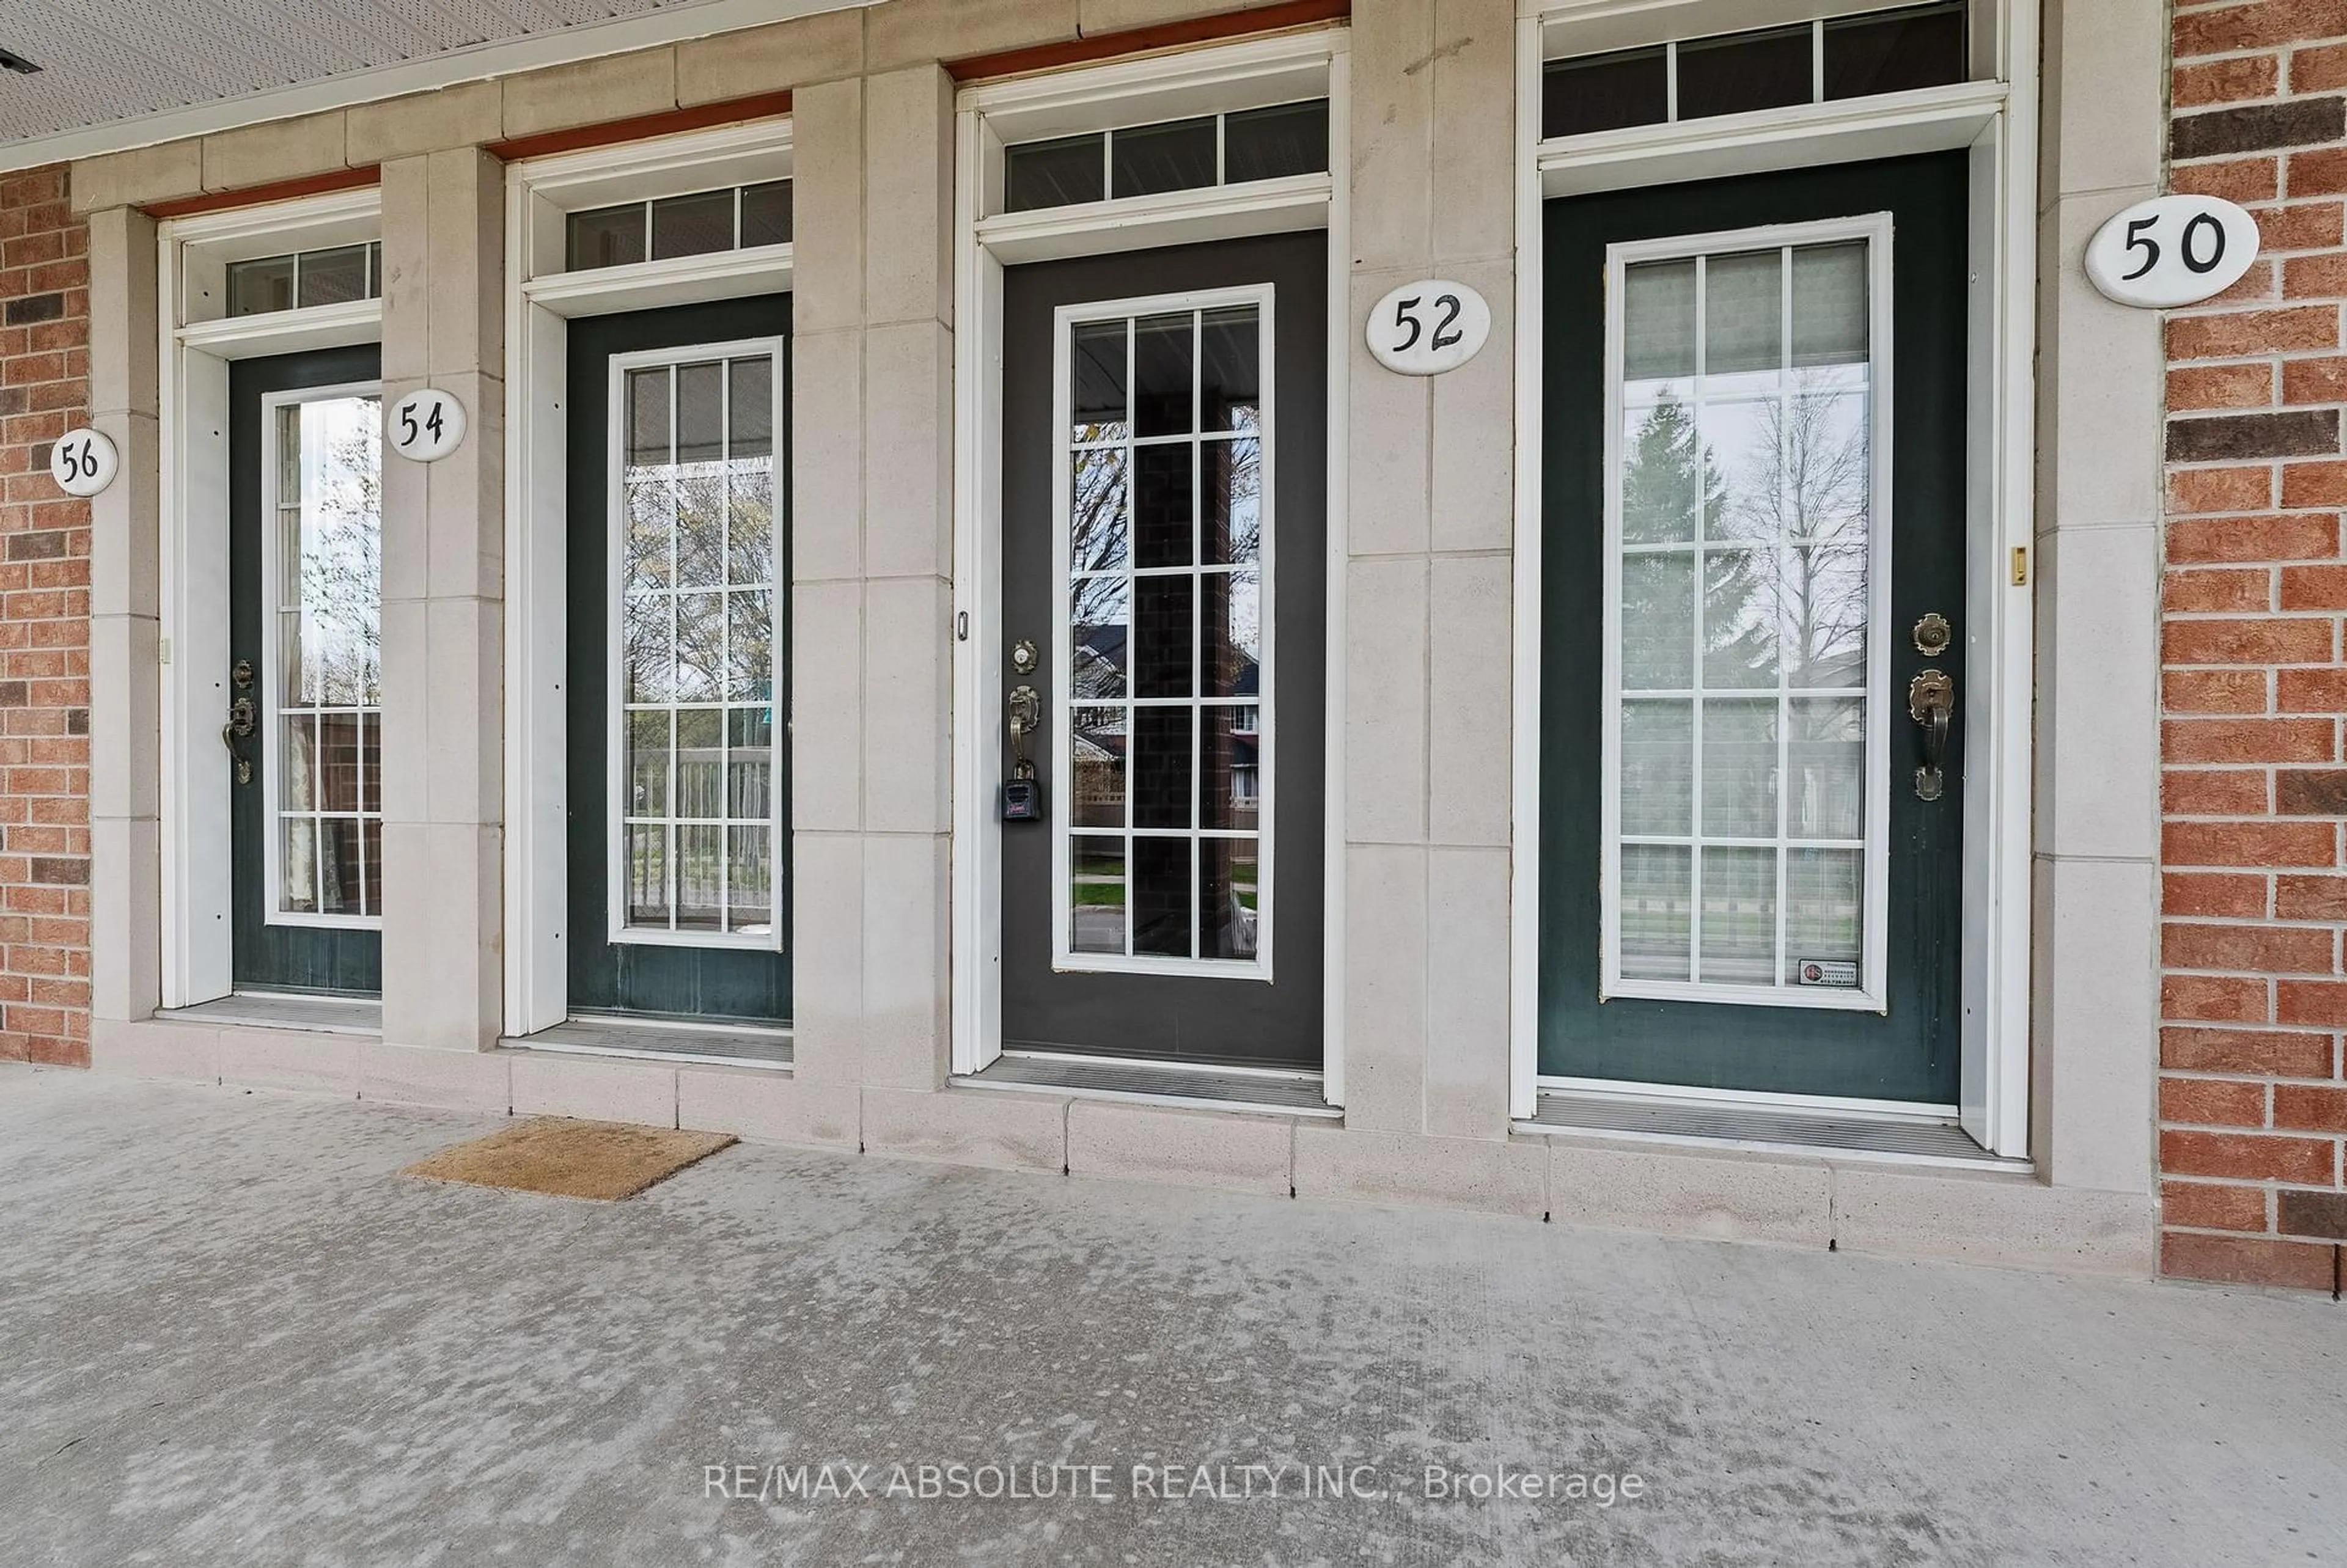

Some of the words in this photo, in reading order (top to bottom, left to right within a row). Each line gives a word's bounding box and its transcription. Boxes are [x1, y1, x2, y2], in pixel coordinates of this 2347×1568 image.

[2122, 212, 2225, 280] 50
[1393, 295, 1463, 352] 52
[401, 402, 443, 446] 54
[62, 438, 98, 483] 56
